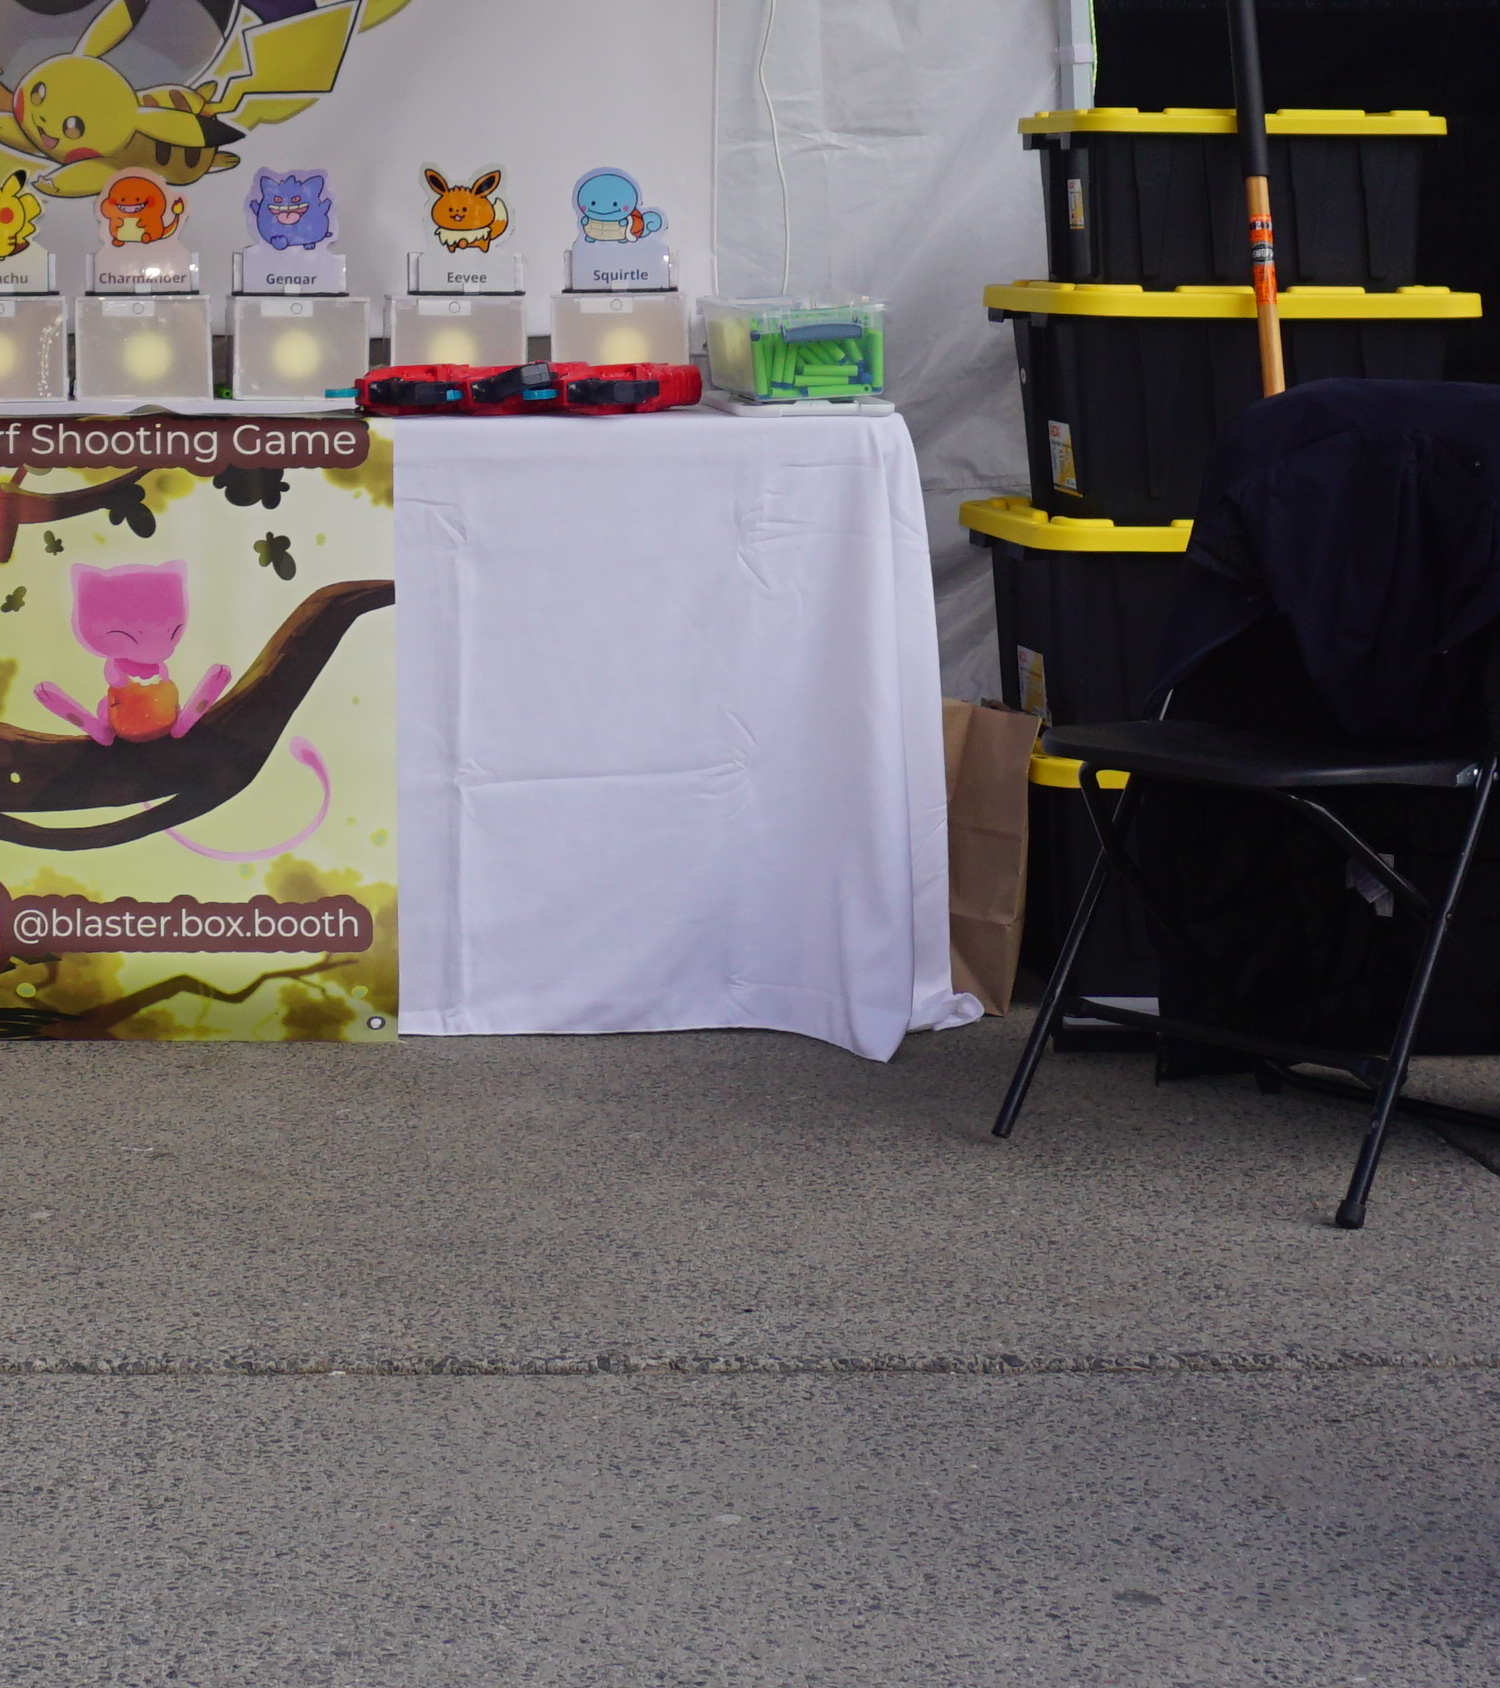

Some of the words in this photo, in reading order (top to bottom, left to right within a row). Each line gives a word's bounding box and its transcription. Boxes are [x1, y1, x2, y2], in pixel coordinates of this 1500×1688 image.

[446, 271, 488, 284] Eevee
[593, 268, 649, 285] Squirtle
[31, 421, 220, 464] Shooting
[232, 424, 358, 457] Game
[12, 906, 362, 943] @blaster.box.booth
